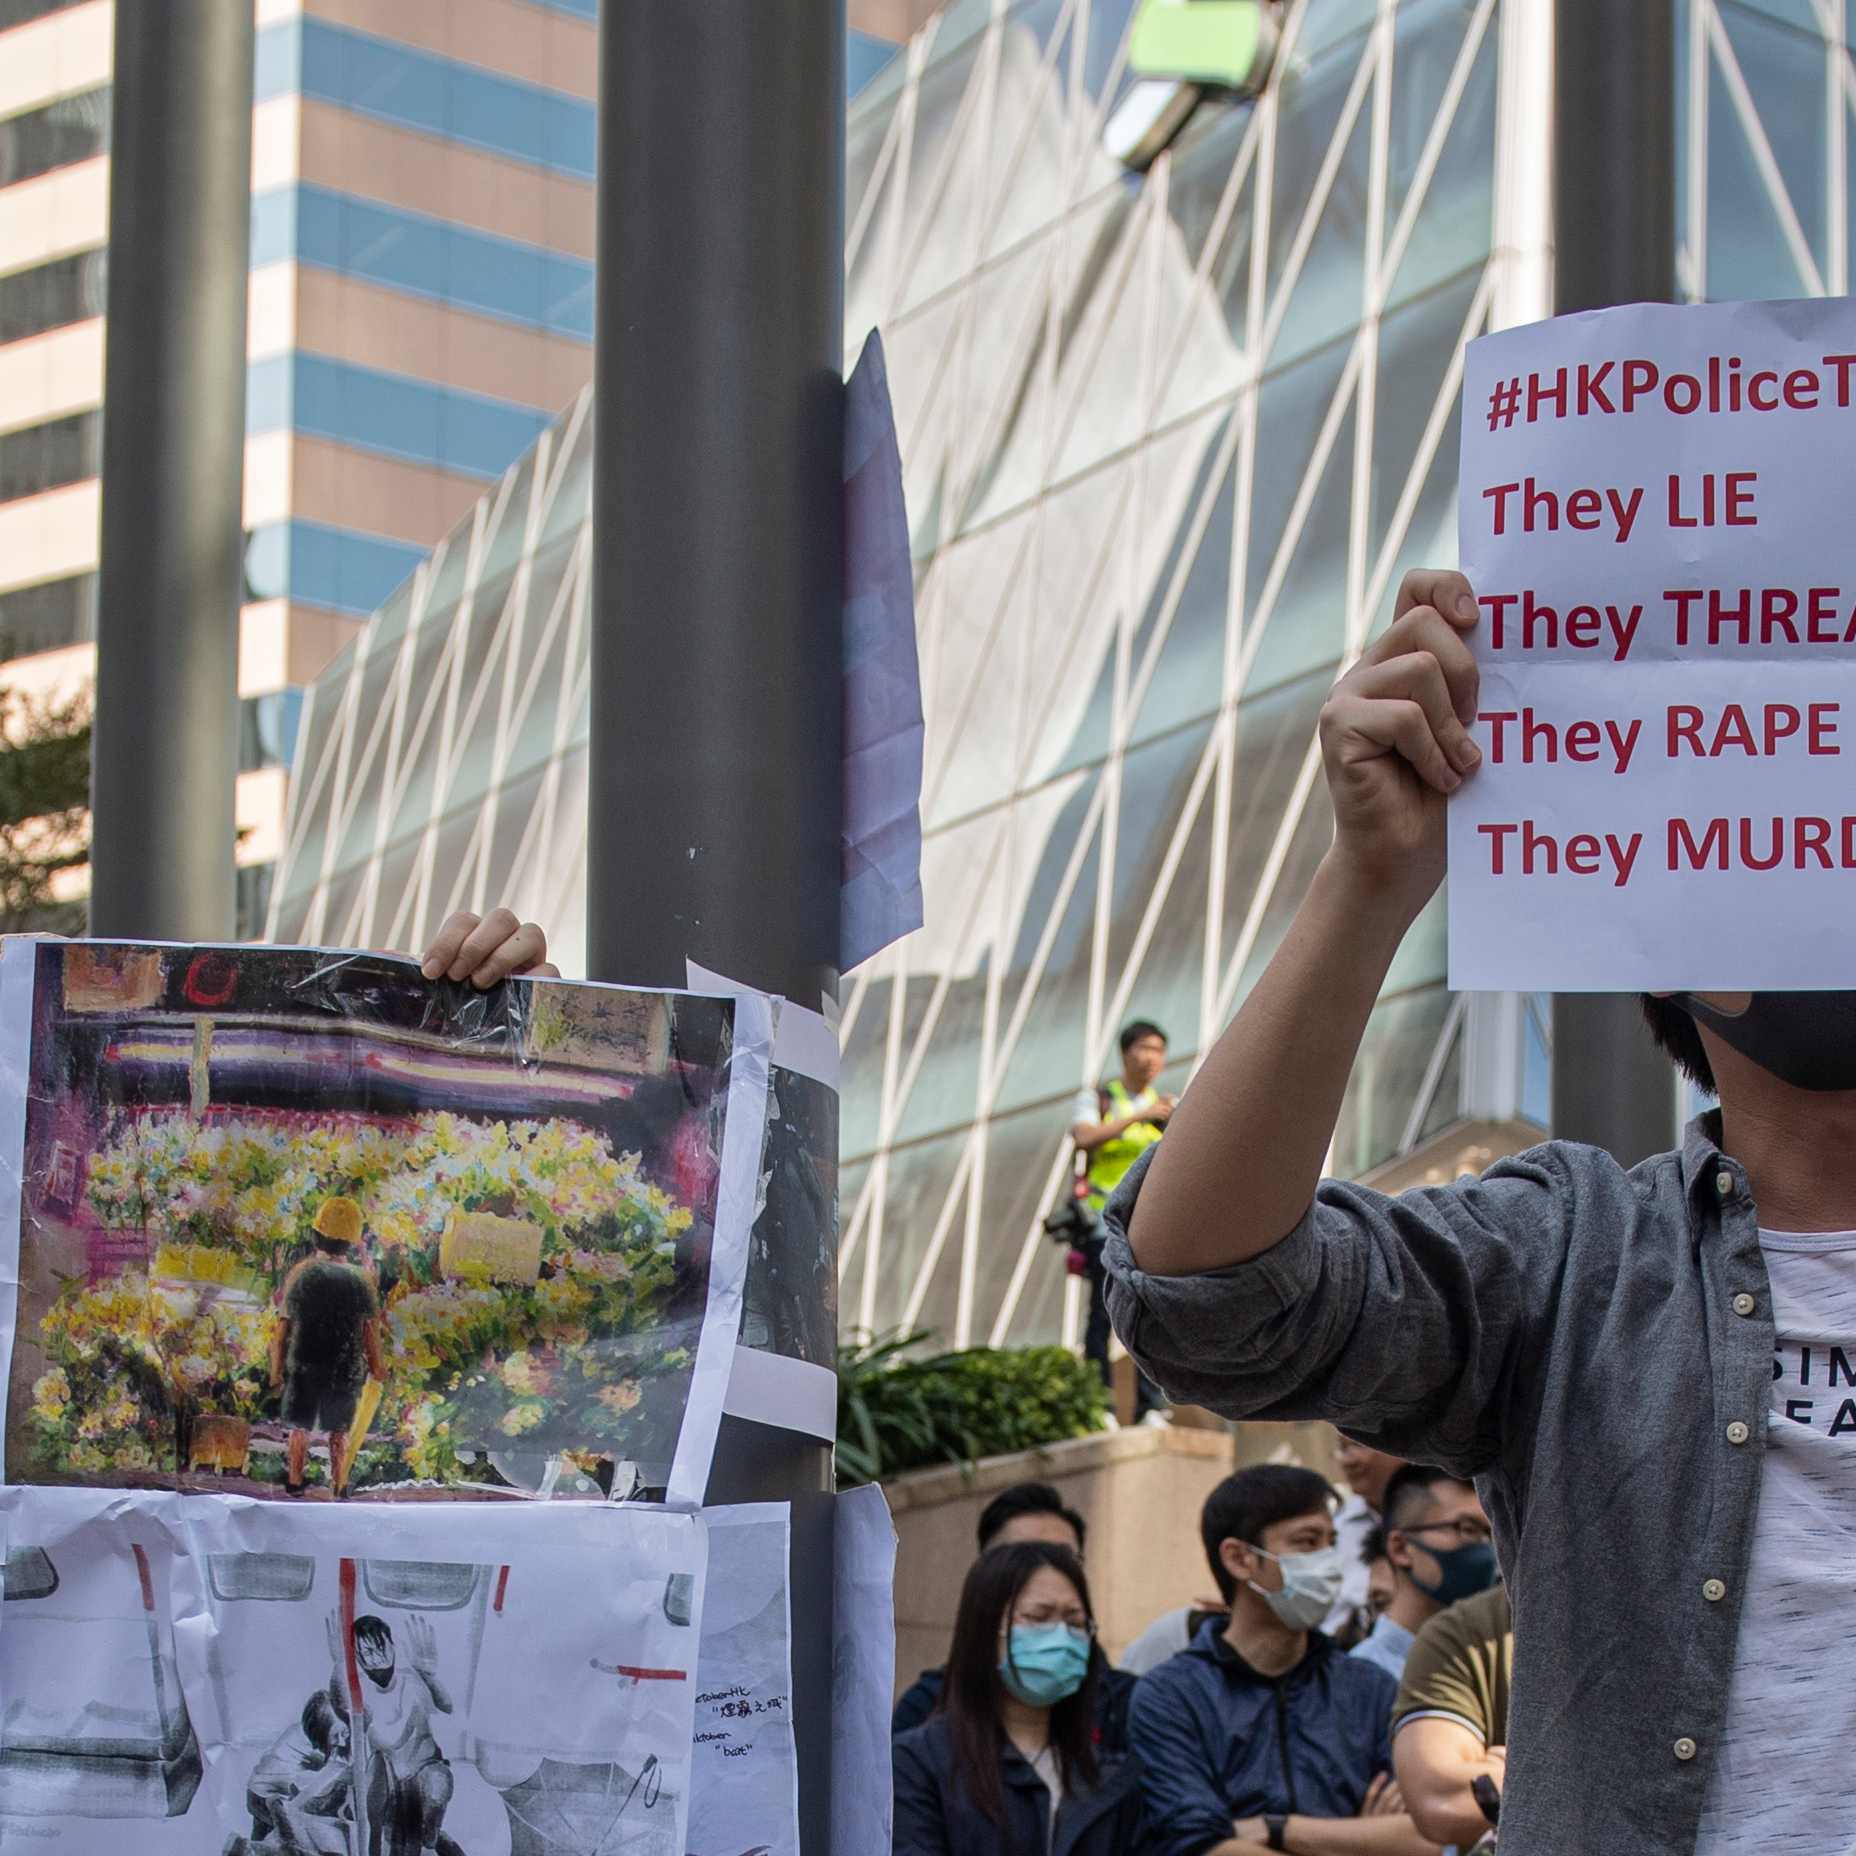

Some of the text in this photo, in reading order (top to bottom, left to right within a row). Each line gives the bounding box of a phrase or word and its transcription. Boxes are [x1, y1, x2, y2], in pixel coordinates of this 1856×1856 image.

[1483, 472, 1757, 543] They LIE
[1478, 591, 1642, 662] They
[1478, 703, 1841, 774] They RAPE
[1478, 821, 1641, 886] They
